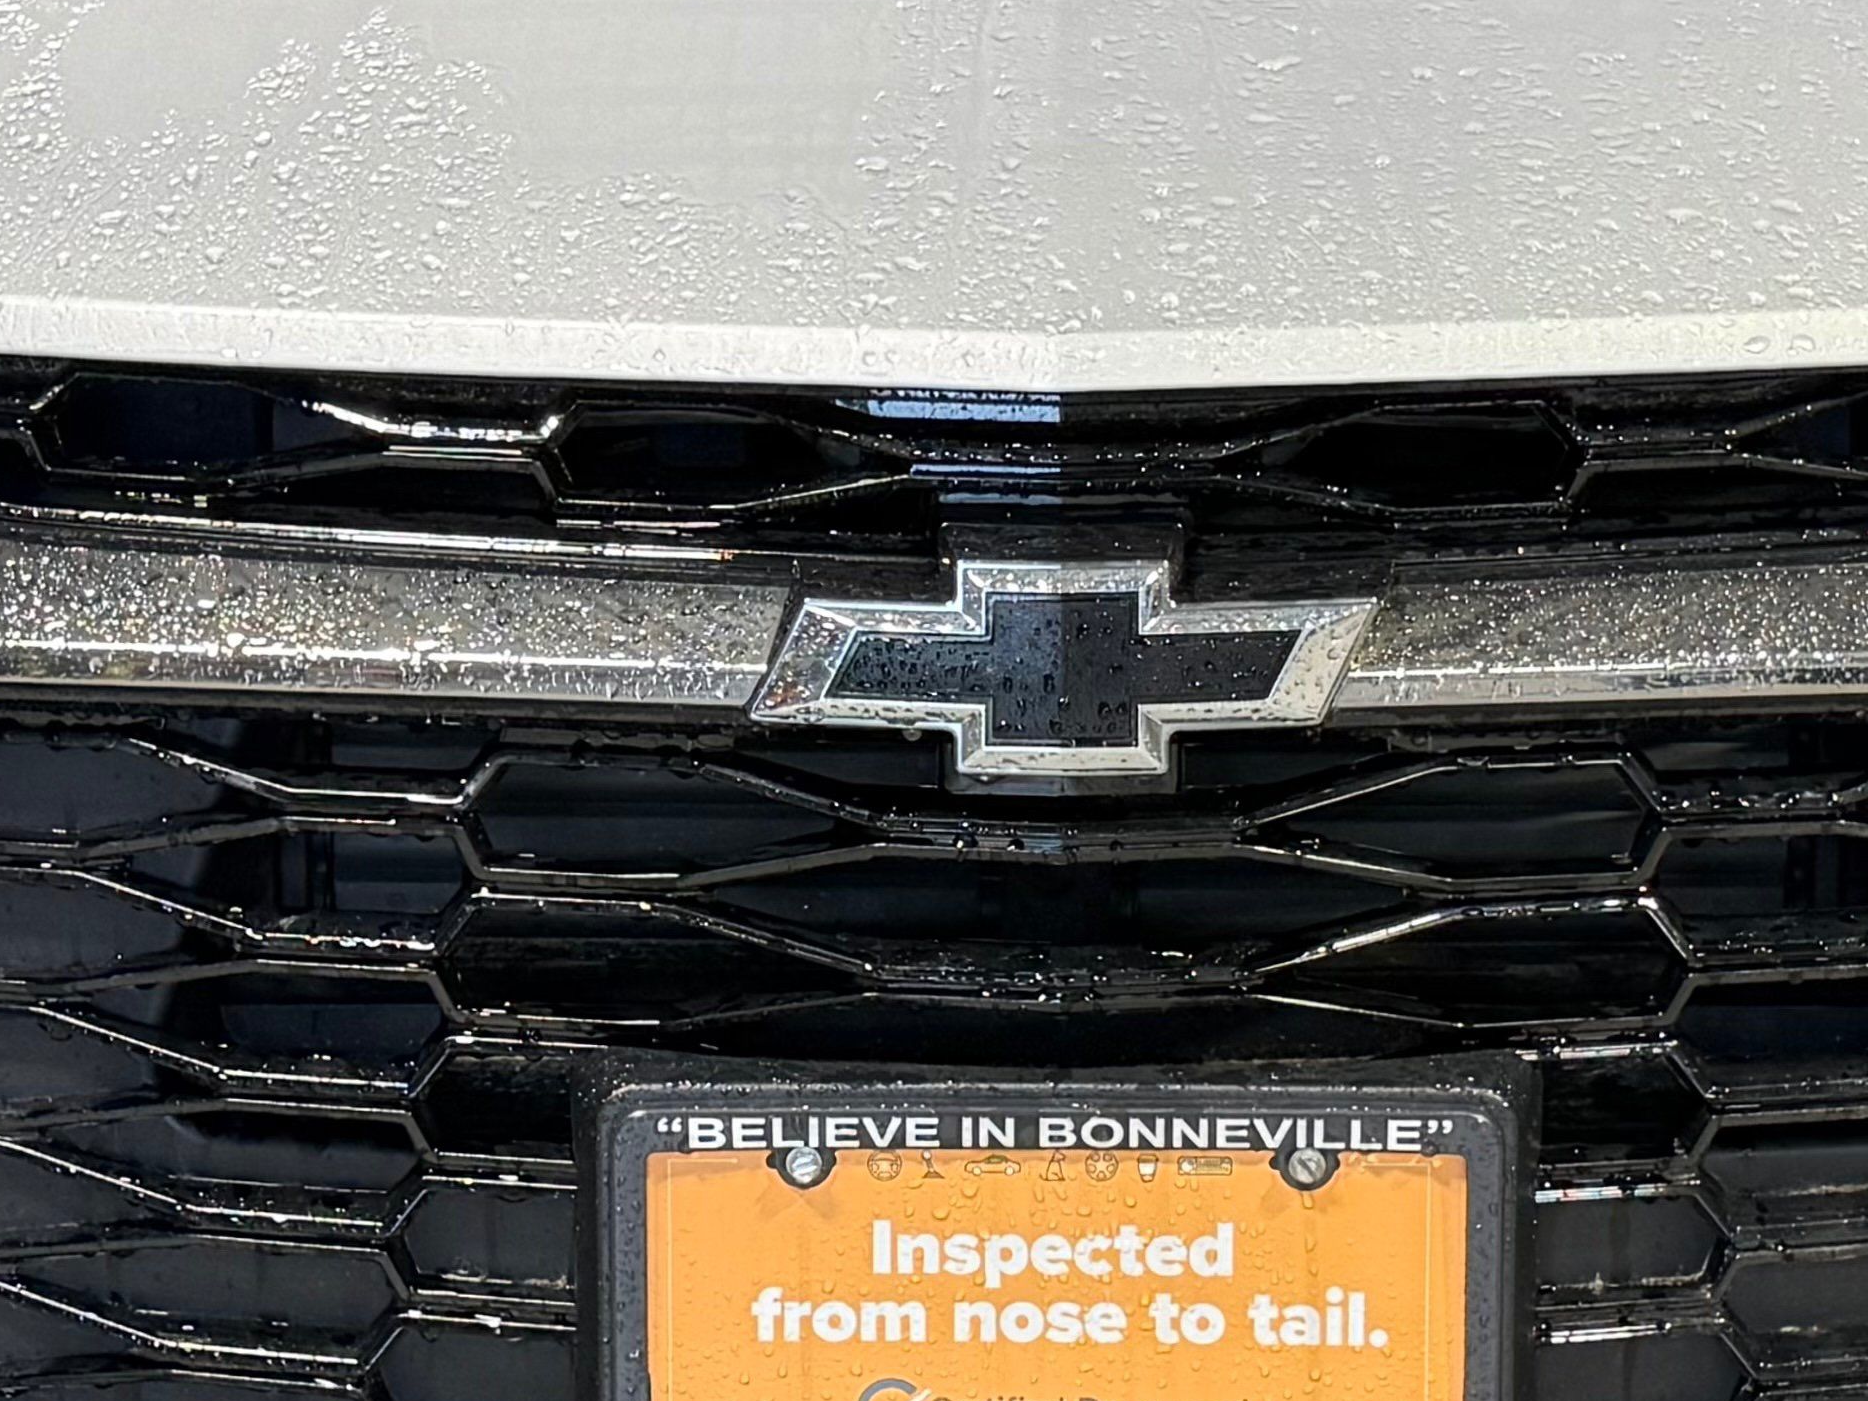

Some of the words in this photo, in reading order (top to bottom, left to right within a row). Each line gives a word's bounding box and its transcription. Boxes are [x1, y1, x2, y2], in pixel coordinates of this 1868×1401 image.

[961, 1116, 1015, 1149] IN
[871, 1219, 1234, 1289] Inspected
[751, 1286, 928, 1343] from
[953, 1299, 1128, 1346] nose
[1148, 1293, 1227, 1347] to
[1247, 1285, 1391, 1349] tail.
